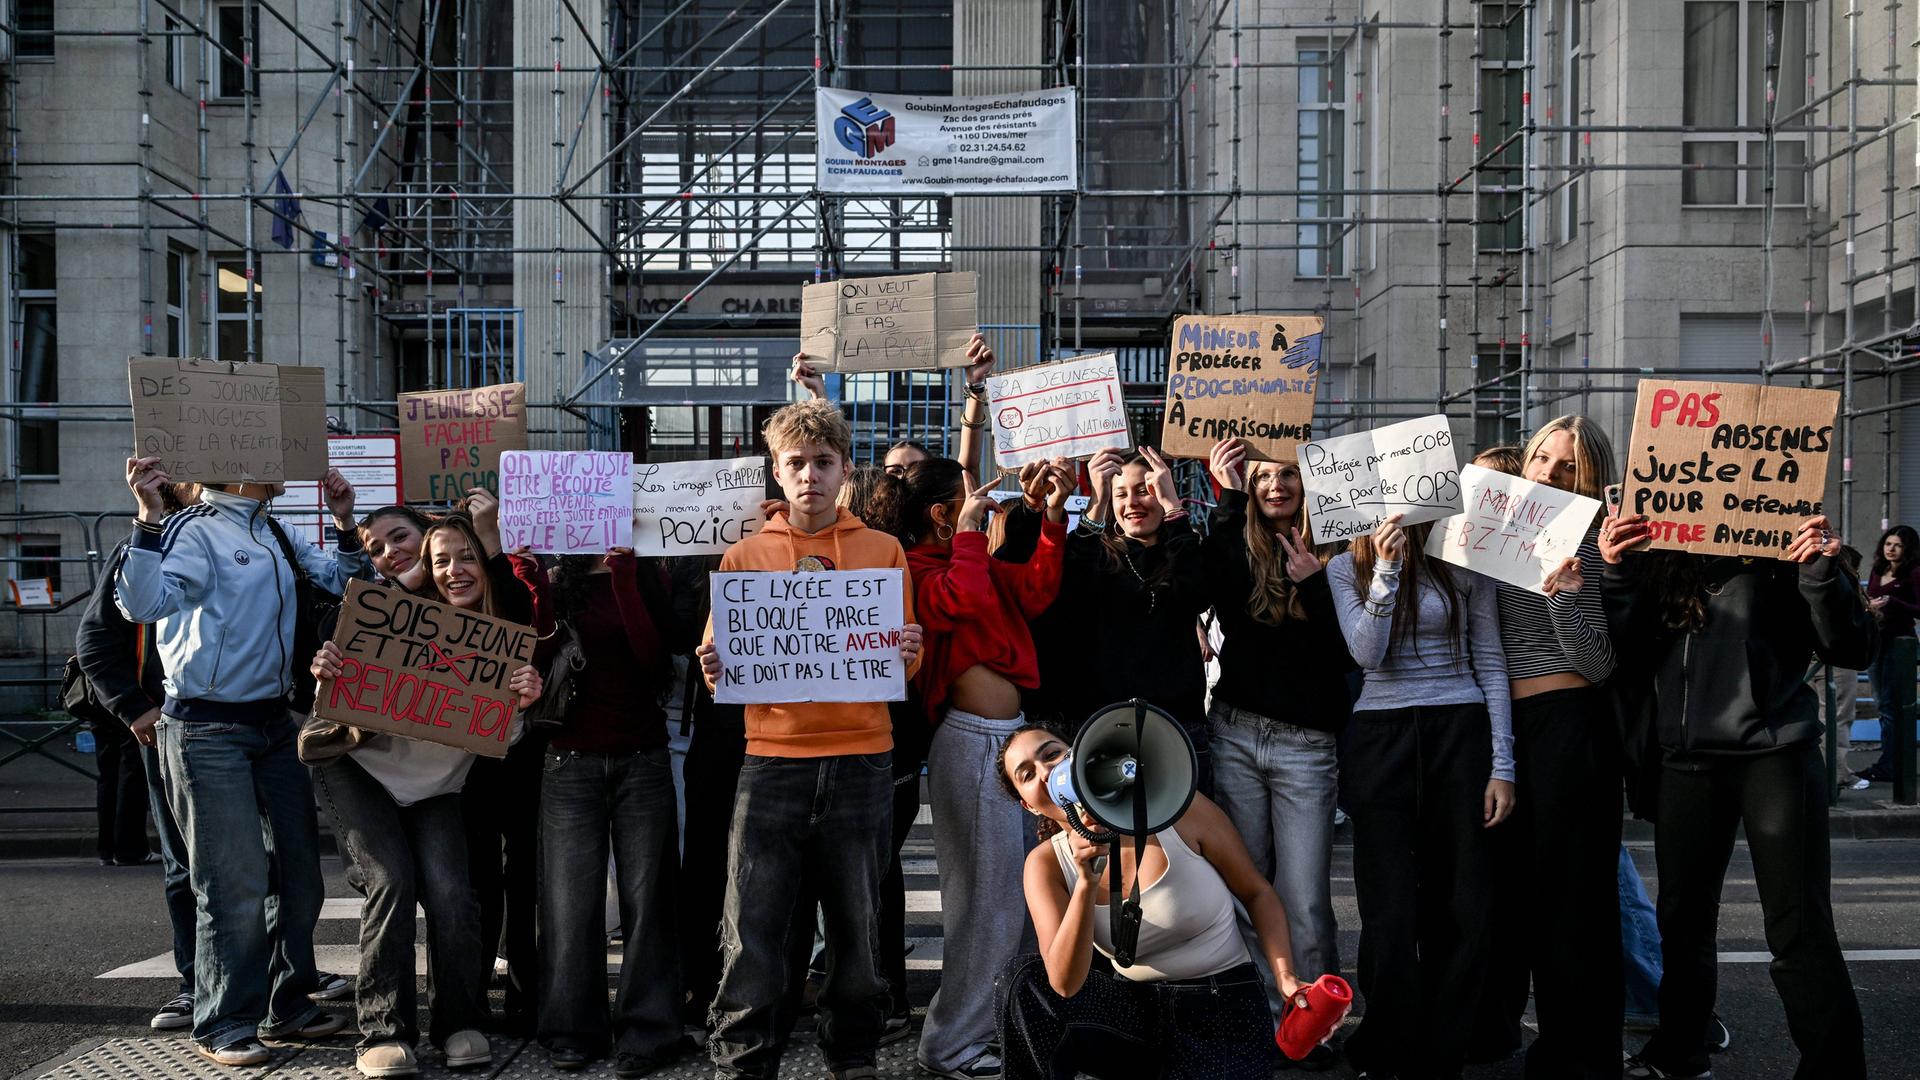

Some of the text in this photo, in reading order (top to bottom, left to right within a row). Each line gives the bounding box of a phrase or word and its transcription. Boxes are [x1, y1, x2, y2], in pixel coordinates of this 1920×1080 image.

[905, 97, 1066, 113] GoubinMontagesEchafaudages
[940, 120, 1036, 133] Avenue des résistants
[943, 111, 1032, 123] Zac des grands prés
[982, 131, 1027, 140] Dives/mer
[960, 143, 1026, 152] 02.31.24.54.62
[855, 159, 906, 167] MONTAGES
[932, 156, 1044, 166] gme14andre@gmail.com
[902, 174, 1068, 185] www.Goubin-montage-échafaudage.com
[842, 280, 918, 298] ON VEUT
[721, 298, 801, 313] CHARLE
[845, 299, 911, 314] LE BAC
[843, 337, 870, 357] LA
[1271, 323, 1288, 351] À
[1035, 366, 1115, 389] JEUNESSE
[140, 376, 301, 403] DES JOURNÉES
[1027, 389, 1100, 413] EMMERDE
[148, 405, 267, 428] + LONGUES
[406, 389, 518, 421] JEUNESSE
[1168, 393, 1186, 427] À
[1651, 388, 1723, 428] PAS
[144, 433, 309, 455] QUE LA RELATION
[1305, 430, 1451, 481] Protégée par mes COPS
[211, 461, 249, 475] MON
[263, 462, 283, 475] EX
[440, 446, 480, 469] PAS
[540, 453, 577, 476] VEUT
[582, 453, 629, 477] JUSTE
[1751, 450, 1800, 483] LÀ
[504, 474, 540, 496] ETRE
[633, 463, 665, 492] Les
[673, 470, 713, 497] images
[548, 495, 596, 510] AVENIR
[1317, 470, 1460, 516] pas par les COPS
[1635, 487, 1704, 514] POUR
[504, 514, 532, 527] VOUS
[536, 510, 560, 525] ETES
[563, 508, 595, 523] JUSTE
[665, 504, 700, 513] moins
[706, 504, 724, 517] que
[733, 500, 743, 511] la
[565, 524, 600, 550] BZ
[1320, 515, 1388, 539] #Solidarit
[1644, 520, 1706, 543] OTRE
[723, 576, 887, 603] CE LYCÉE EST
[355, 589, 537, 663] SOIS JEUNE
[728, 602, 880, 633] BLOQUÉ PARCE
[345, 630, 394, 659] ET
[728, 634, 765, 656] QUE
[774, 633, 840, 656] NOTRE
[725, 664, 745, 687] NE
[795, 662, 824, 680] PAS
[831, 657, 892, 681] L'ÊTRE
